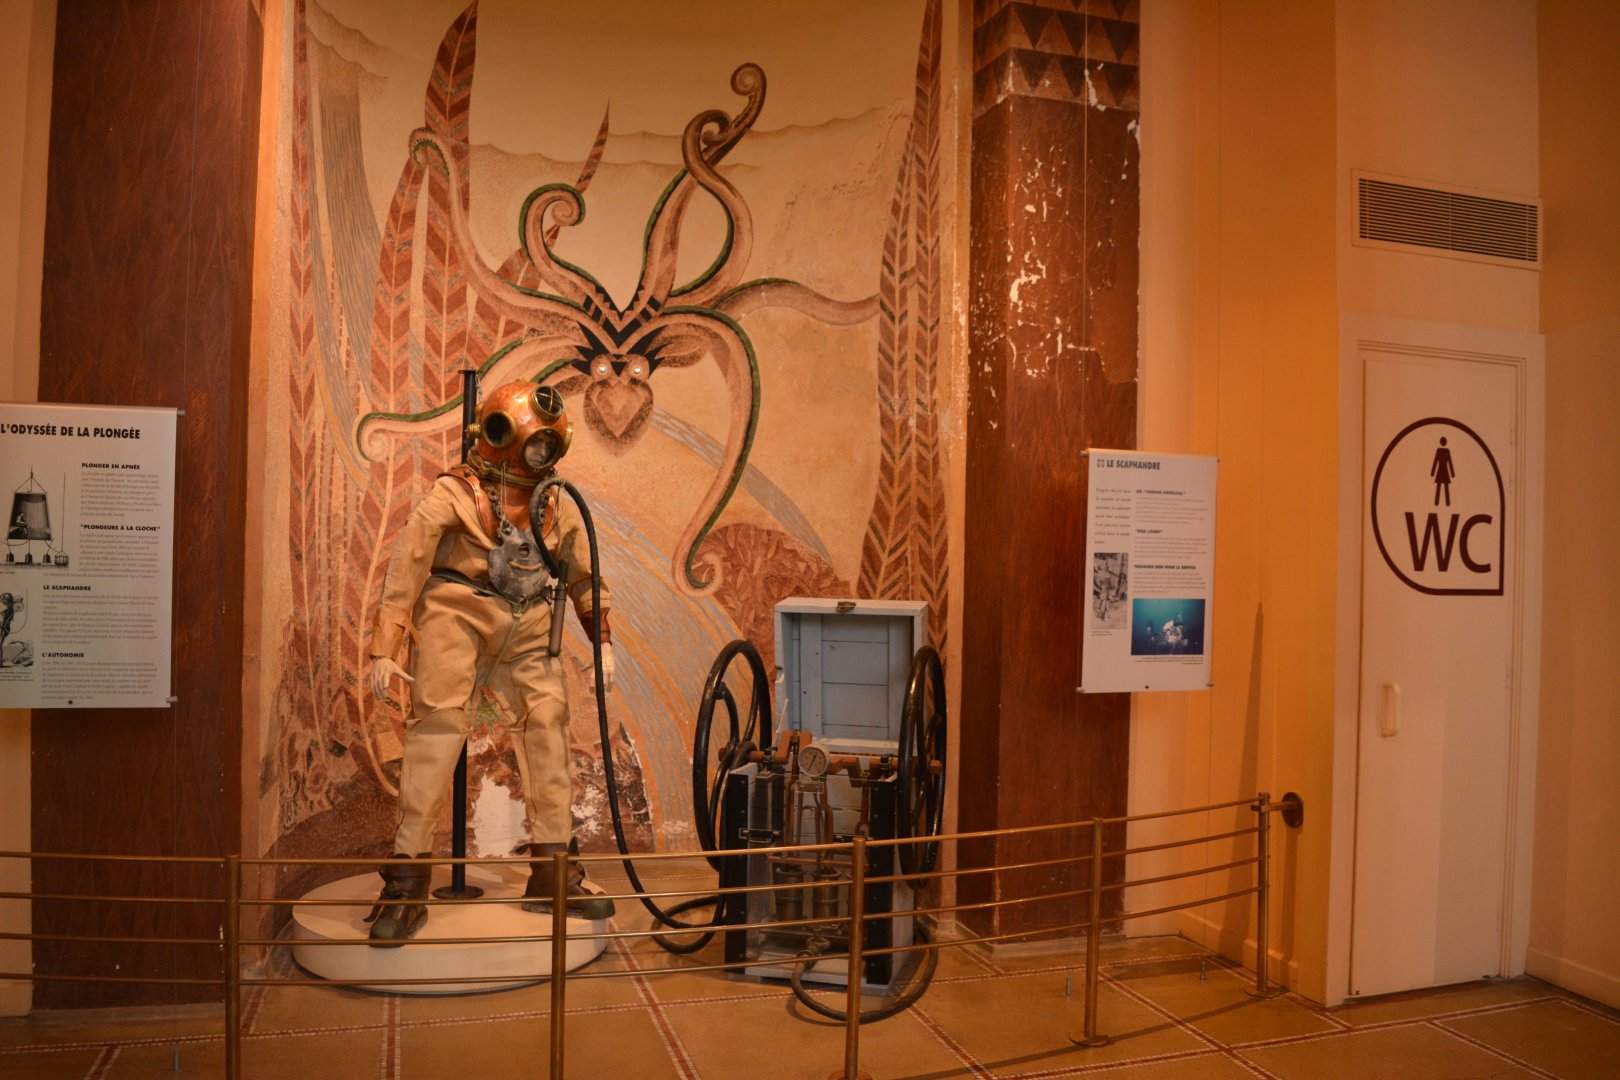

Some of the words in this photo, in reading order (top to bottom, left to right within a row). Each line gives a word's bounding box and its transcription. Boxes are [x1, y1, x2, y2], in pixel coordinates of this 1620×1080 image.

[0, 423, 57, 436] L'ODYSSÉE
[60, 426, 73, 437] DE
[77, 427, 90, 437] LA
[93, 427, 141, 439] PLONGÉE
[1106, 459, 1114, 468] LE
[1116, 460, 1161, 470] SCAPHANDRE
[1405, 512, 1493, 573] WC
